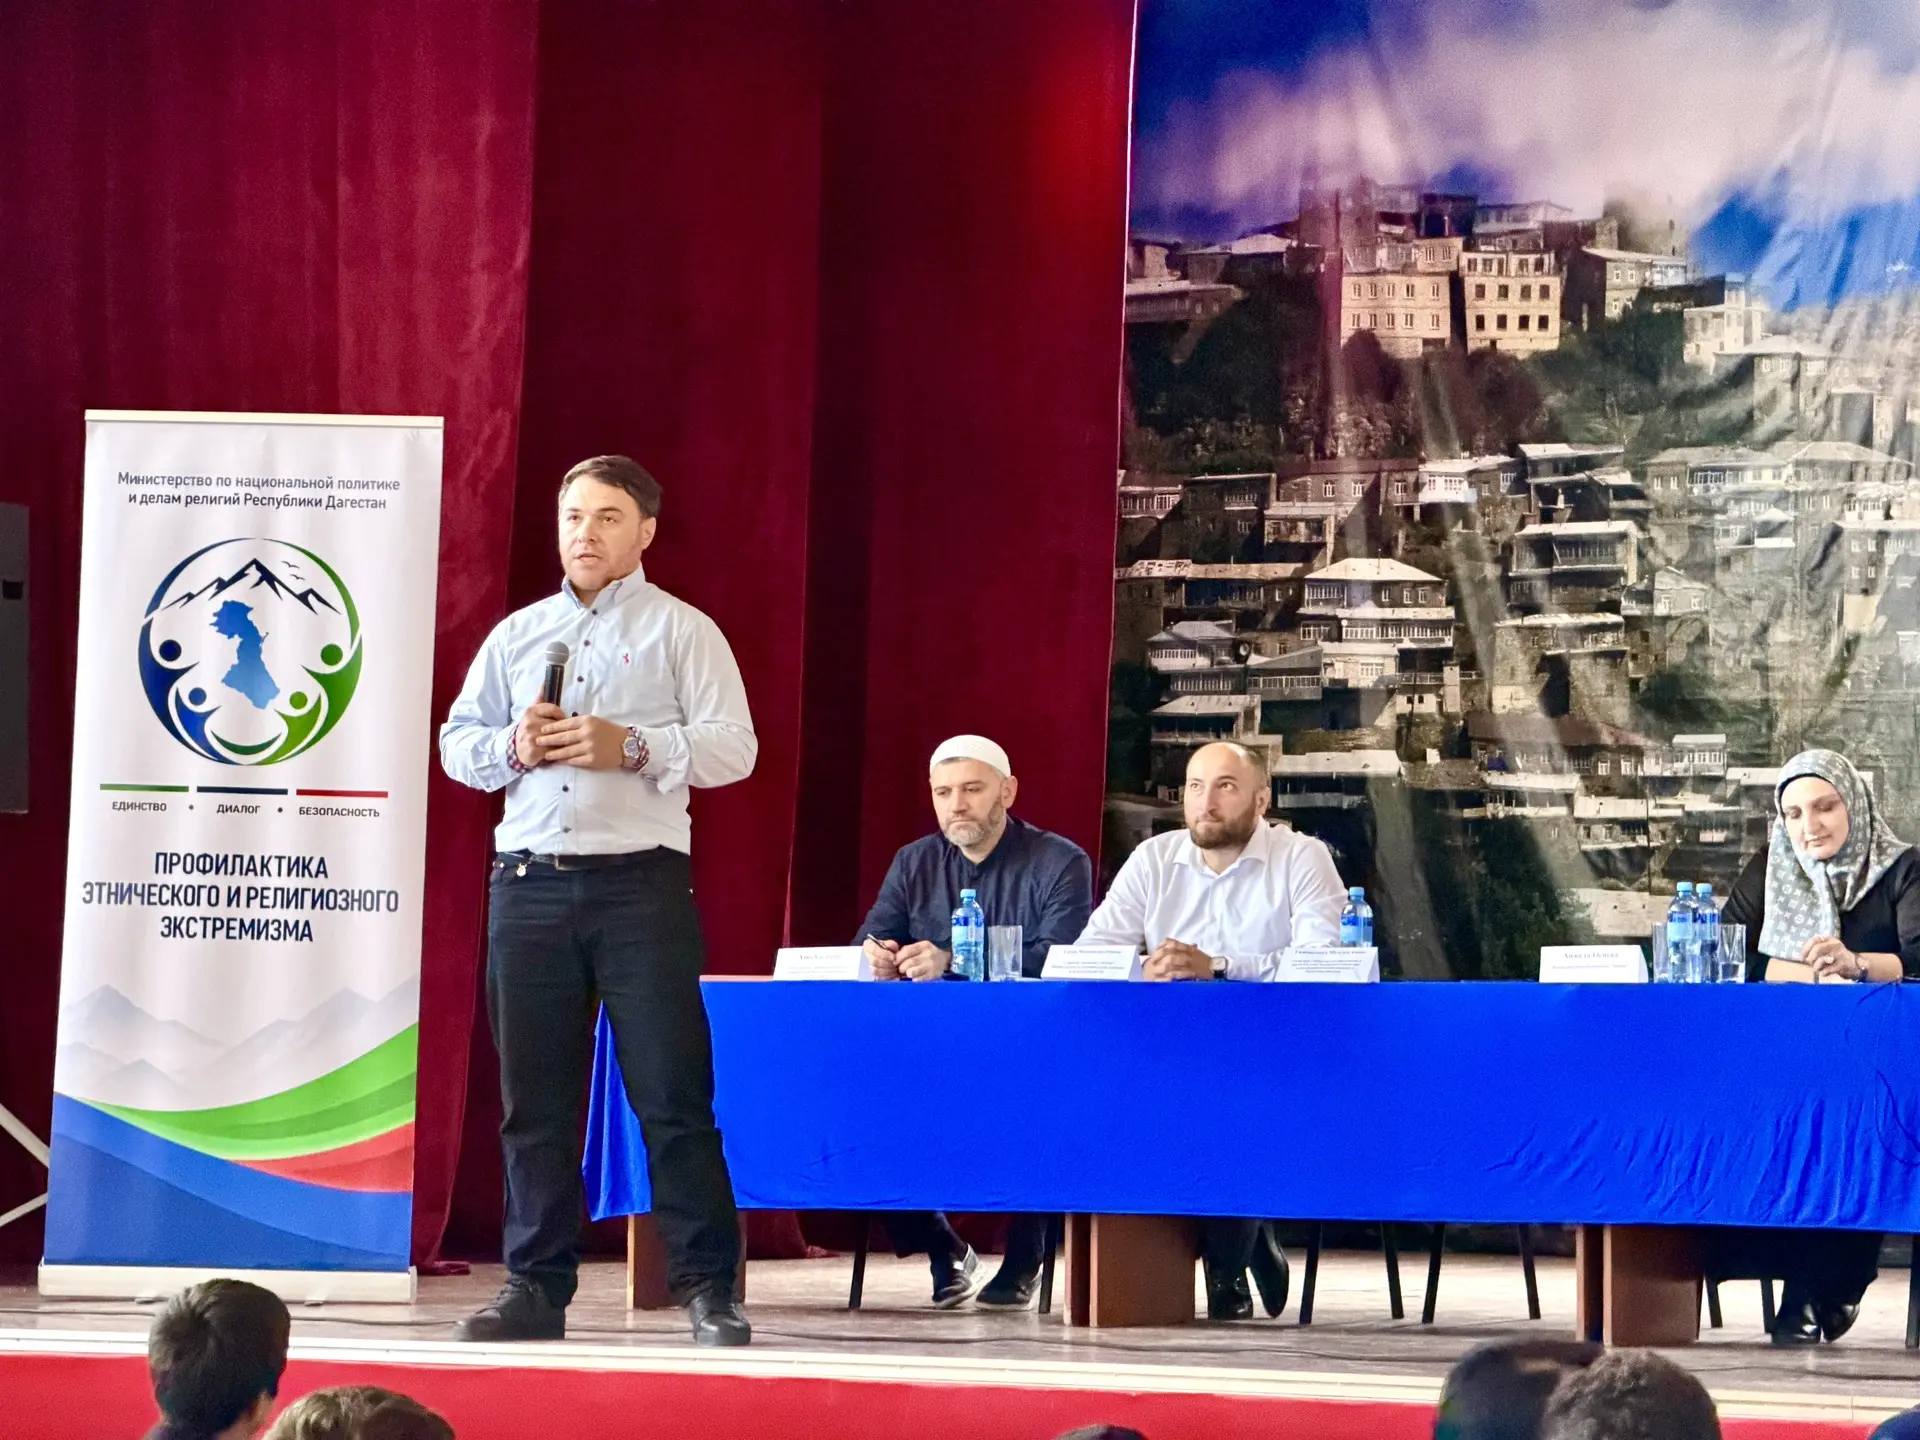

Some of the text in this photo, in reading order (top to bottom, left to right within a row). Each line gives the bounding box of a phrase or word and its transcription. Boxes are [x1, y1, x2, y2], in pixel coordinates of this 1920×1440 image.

[118, 472, 400, 490] Министерство по национальной политике
[128, 493, 386, 511] и делам религий Республики Дагестан
[112, 801, 379, 817] ЕДИНСТВО ДИАЛОГ БЕЗОПАСНОСТЬ
[155, 852, 328, 879] ПРОФИЛАКТИКА
[82, 882, 398, 912] ЭТНИЧЕСКОГО И РЕЛИГИОЗНОГО
[160, 916, 313, 942] ЭКСТРЕМИЗМА
